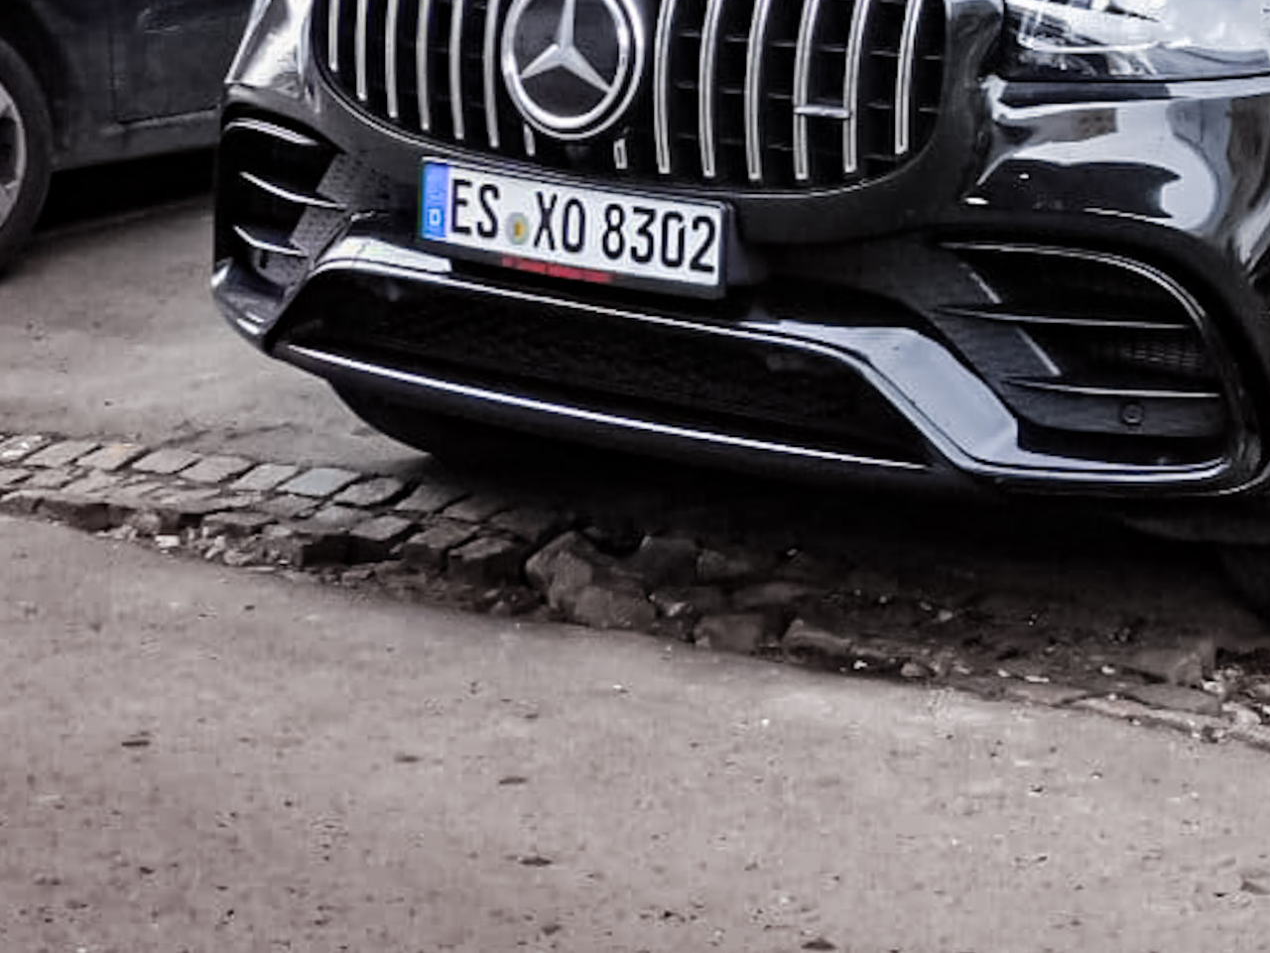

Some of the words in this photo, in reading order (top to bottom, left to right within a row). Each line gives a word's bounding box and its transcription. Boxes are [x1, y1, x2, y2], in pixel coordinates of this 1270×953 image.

[451, 178, 500, 239] ES
[533, 191, 586, 253] XO
[602, 203, 716, 273] 8302
